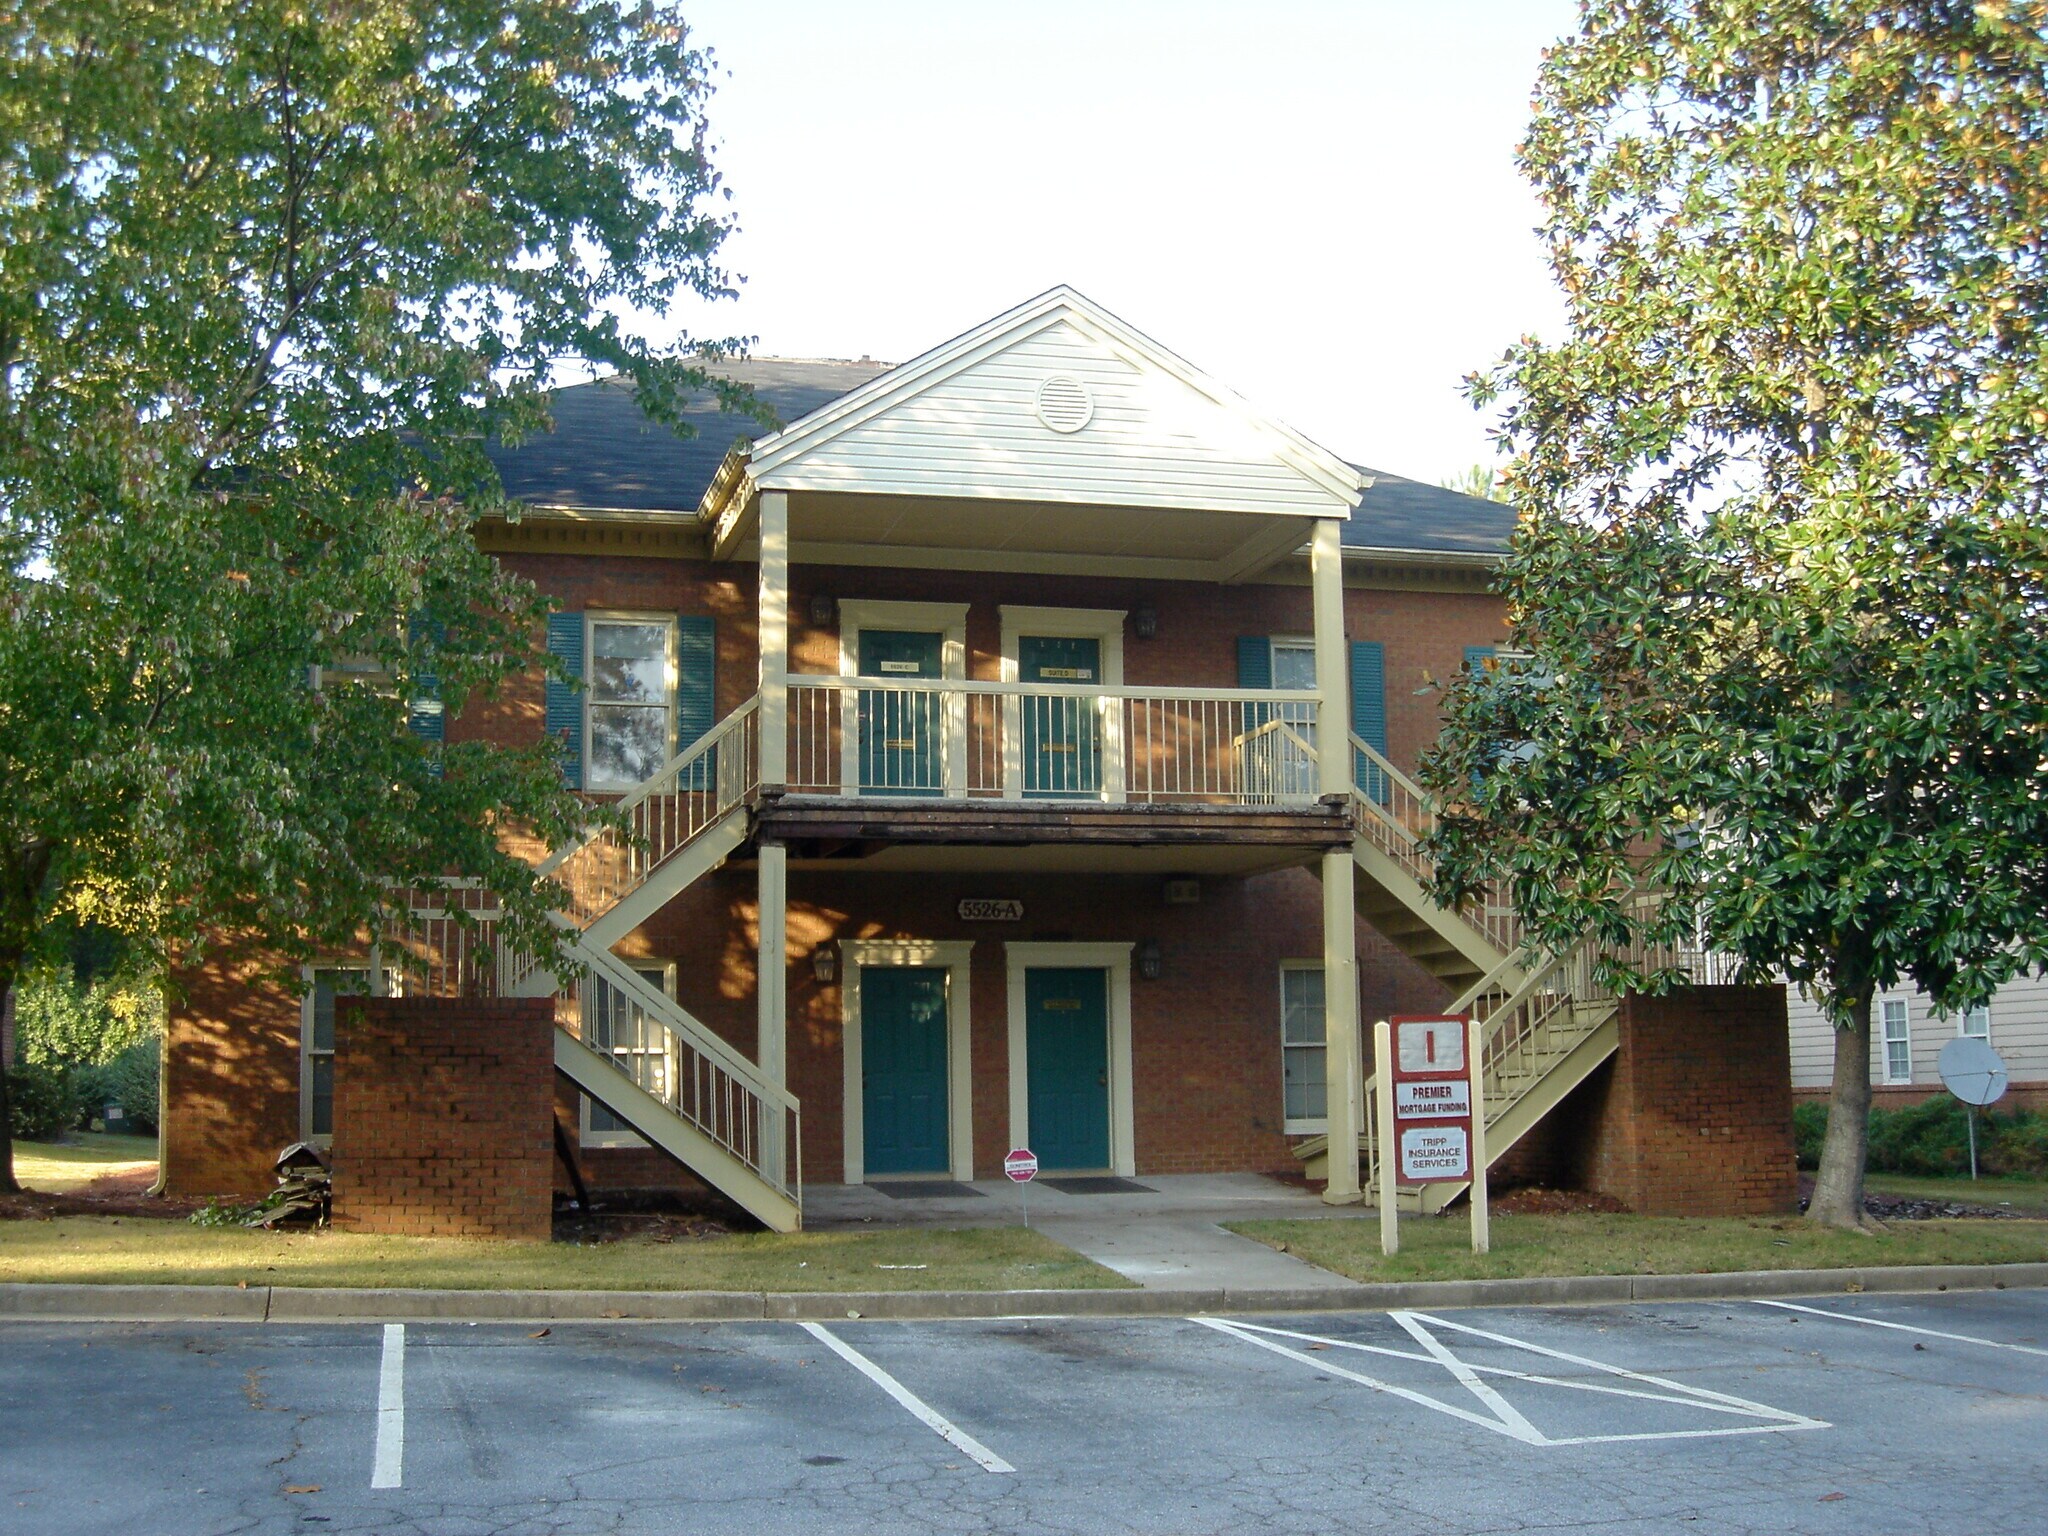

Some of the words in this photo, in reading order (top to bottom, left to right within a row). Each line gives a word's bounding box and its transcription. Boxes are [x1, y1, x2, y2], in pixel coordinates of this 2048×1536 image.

[963, 902, 1019, 918] 5526-A
[1412, 1086, 1452, 1099] PREMIER
[1399, 1103, 1436, 1114] MORTGAGE
[1438, 1102, 1467, 1112] FUNDING
[1422, 1137, 1447, 1147] TRIPP
[1408, 1147, 1461, 1158] INSURANCE
[1412, 1158, 1458, 1169] SERVICES
